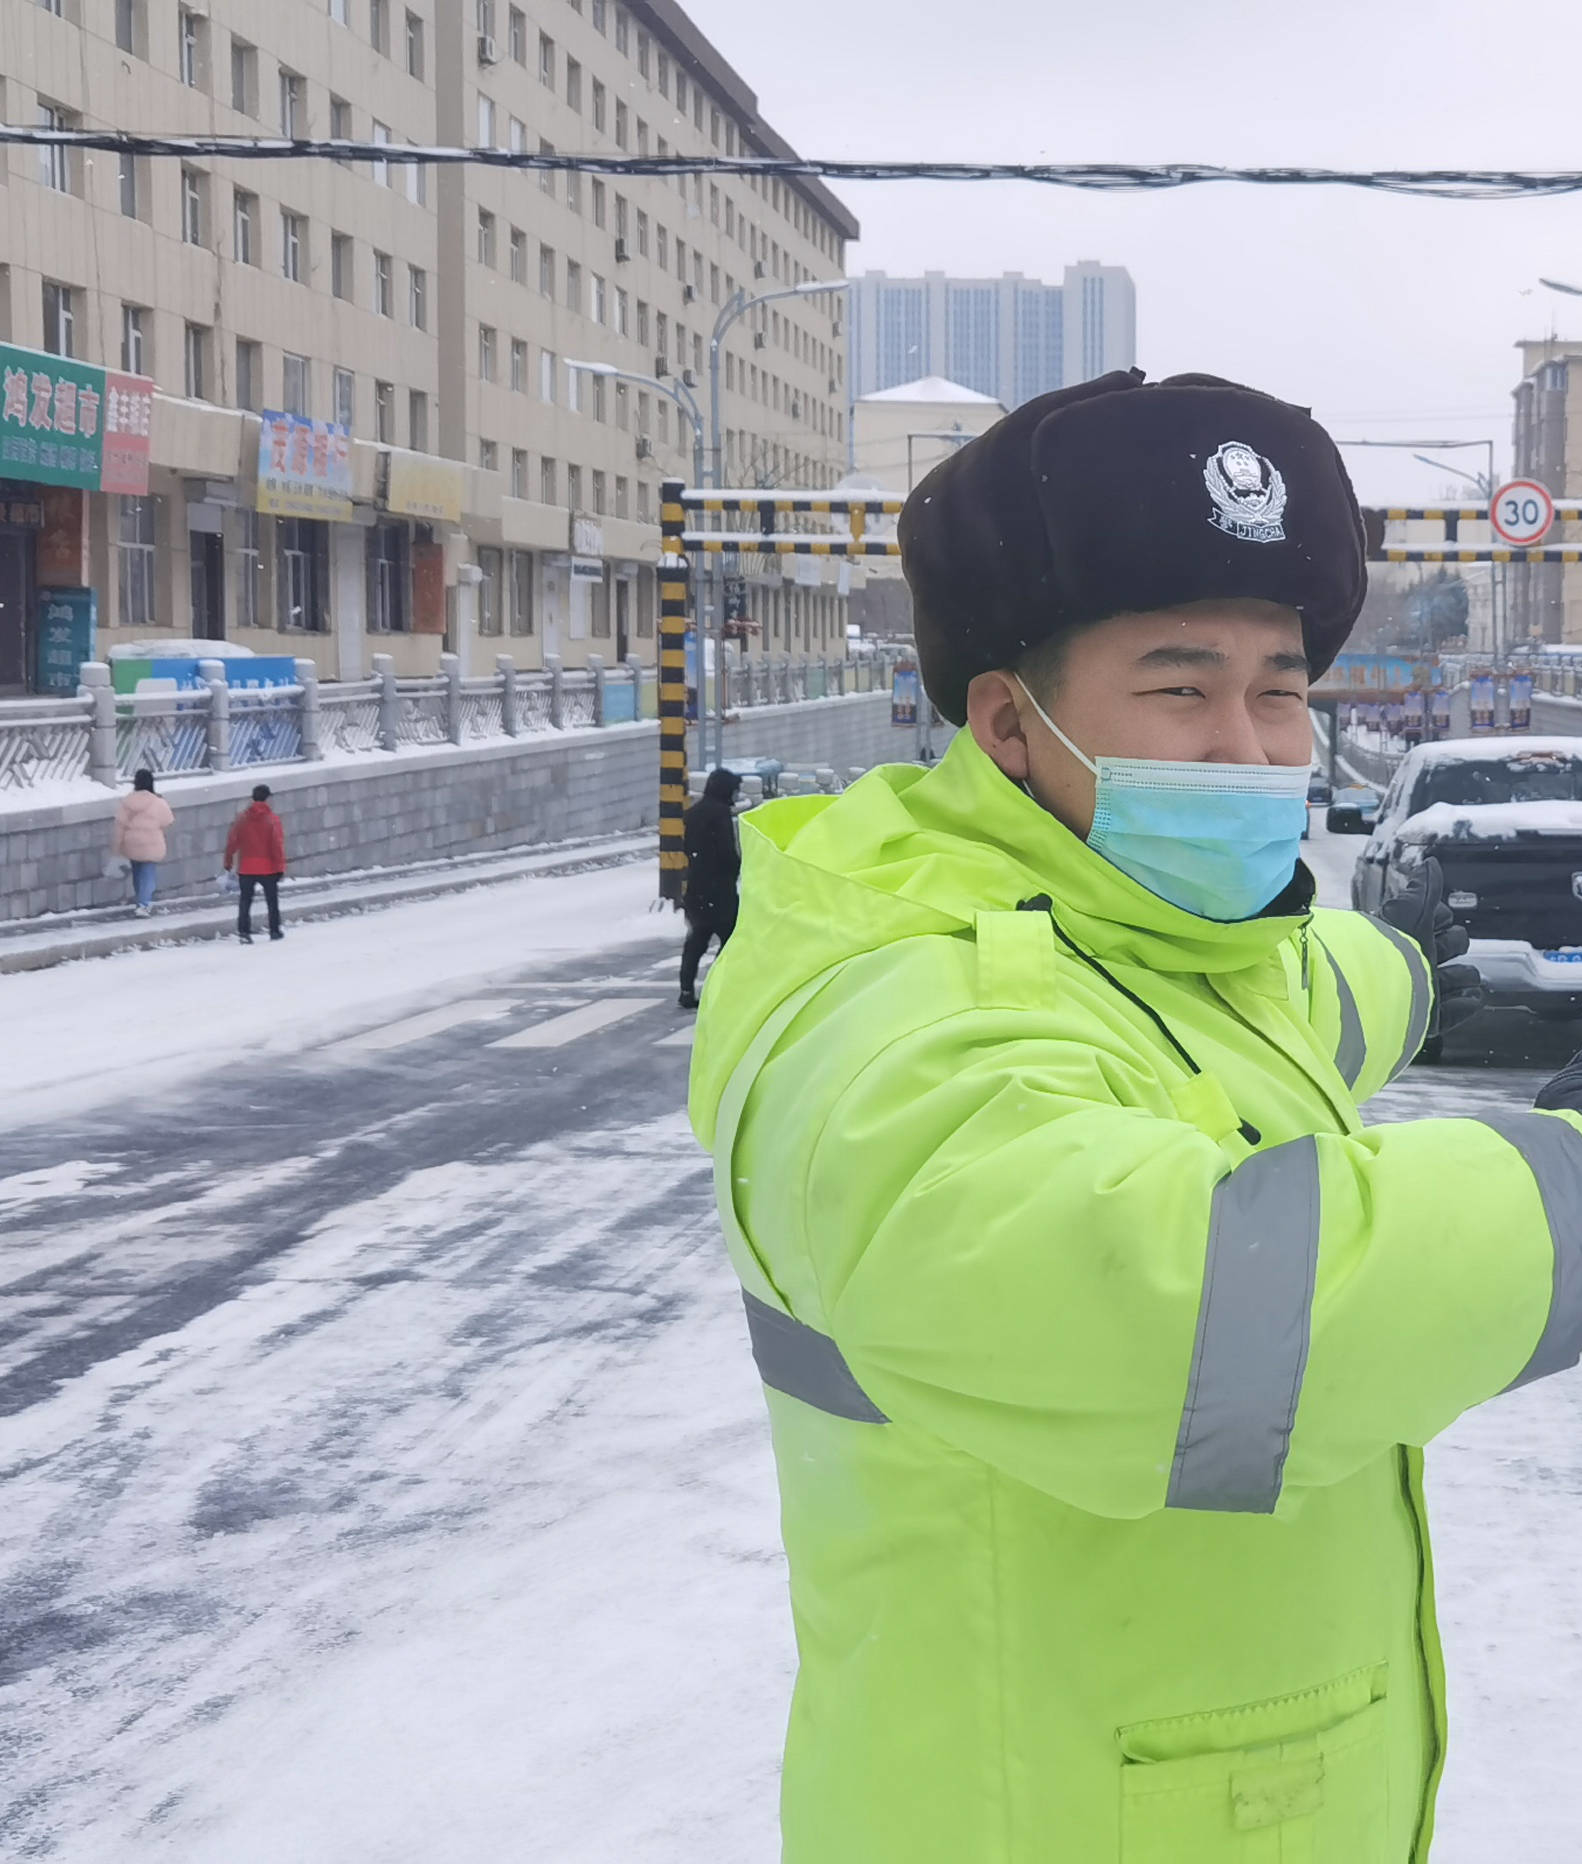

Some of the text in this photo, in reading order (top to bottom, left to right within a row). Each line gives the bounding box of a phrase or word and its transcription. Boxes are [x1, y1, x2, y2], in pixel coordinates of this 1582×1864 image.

[3, 366, 99, 438] 鸿发超市
[1504, 499, 1539, 526] 30
